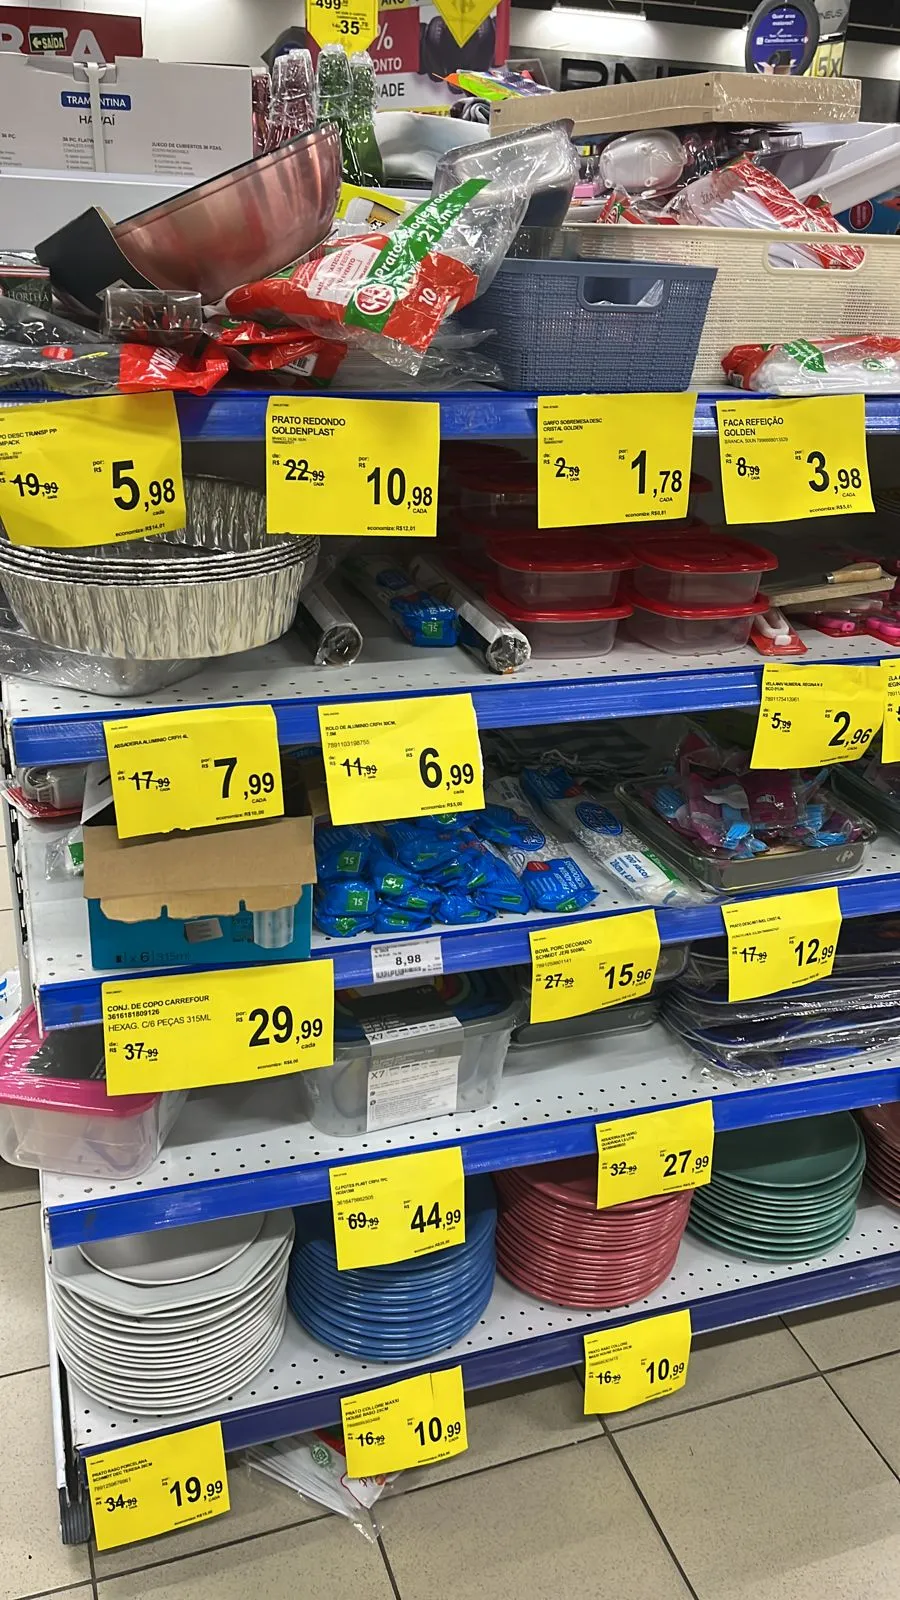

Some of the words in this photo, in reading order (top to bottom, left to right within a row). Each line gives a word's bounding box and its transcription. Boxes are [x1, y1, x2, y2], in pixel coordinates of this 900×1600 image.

[42, 34, 64, 49] SAÍDA
[418, 287, 437, 306] 10
[272, 415, 301, 424] PRATO
[303, 417, 346, 426] REDONDO
[723, 419, 744, 427] FACA
[746, 417, 784, 426] REFEIÇÃO
[25, 429, 48, 437] TRANSP
[272, 426, 335, 436] GOLDENPLAST
[724, 429, 756, 437] GOLDEN
[284, 459, 324, 483] 22,99
[631, 450, 682, 498] 1,78
[736, 457, 760, 478] 8,99
[806, 451, 862, 494] 3,98
[13, 472, 58, 497] 19,99
[111, 460, 175, 512] 5,98
[367, 467, 433, 509] 10,98
[771, 712, 792, 730] 5,99
[828, 711, 872, 747] 2,96
[342, 757, 377, 777] 11,99
[419, 747, 474, 791] 6,99
[130, 771, 170, 791] 17,99
[213, 757, 275, 800] 7,99
[565, 939, 592, 948] DECORADO
[795, 938, 834, 966] 12,99
[140, 951, 150, 962] 6
[395, 954, 421, 967] 8,98
[740, 946, 767, 963] 17,99
[544, 973, 574, 989] 27,99
[605, 963, 652, 990] 15,96
[107, 1003, 130, 1012] CONJ.
[131, 1002, 141, 1010] DE
[142, 999, 164, 1008] COPO
[164, 995, 210, 1006] CARREFOUR
[108, 1022, 139, 1032] HEXAG.
[141, 1020, 155, 1028] C/6
[157, 1016, 185, 1028] PEÇAS
[186, 1014, 211, 1023] 315ML
[249, 1005, 323, 1047] 29,99
[124, 1042, 158, 1060] 37,99
[300, 1042, 316, 1050] cada
[663, 1150, 709, 1177] 27,99
[348, 1212, 379, 1230] 69,99
[411, 1202, 461, 1233] 44,99
[646, 1358, 684, 1384] 10,99
[357, 1432, 385, 1447] 16,99
[414, 1416, 461, 1446] 10,99
[92, 1470, 107, 1478] PRATO
[170, 1476, 223, 1507] 19,99
[106, 1494, 137, 1512] 34,99
